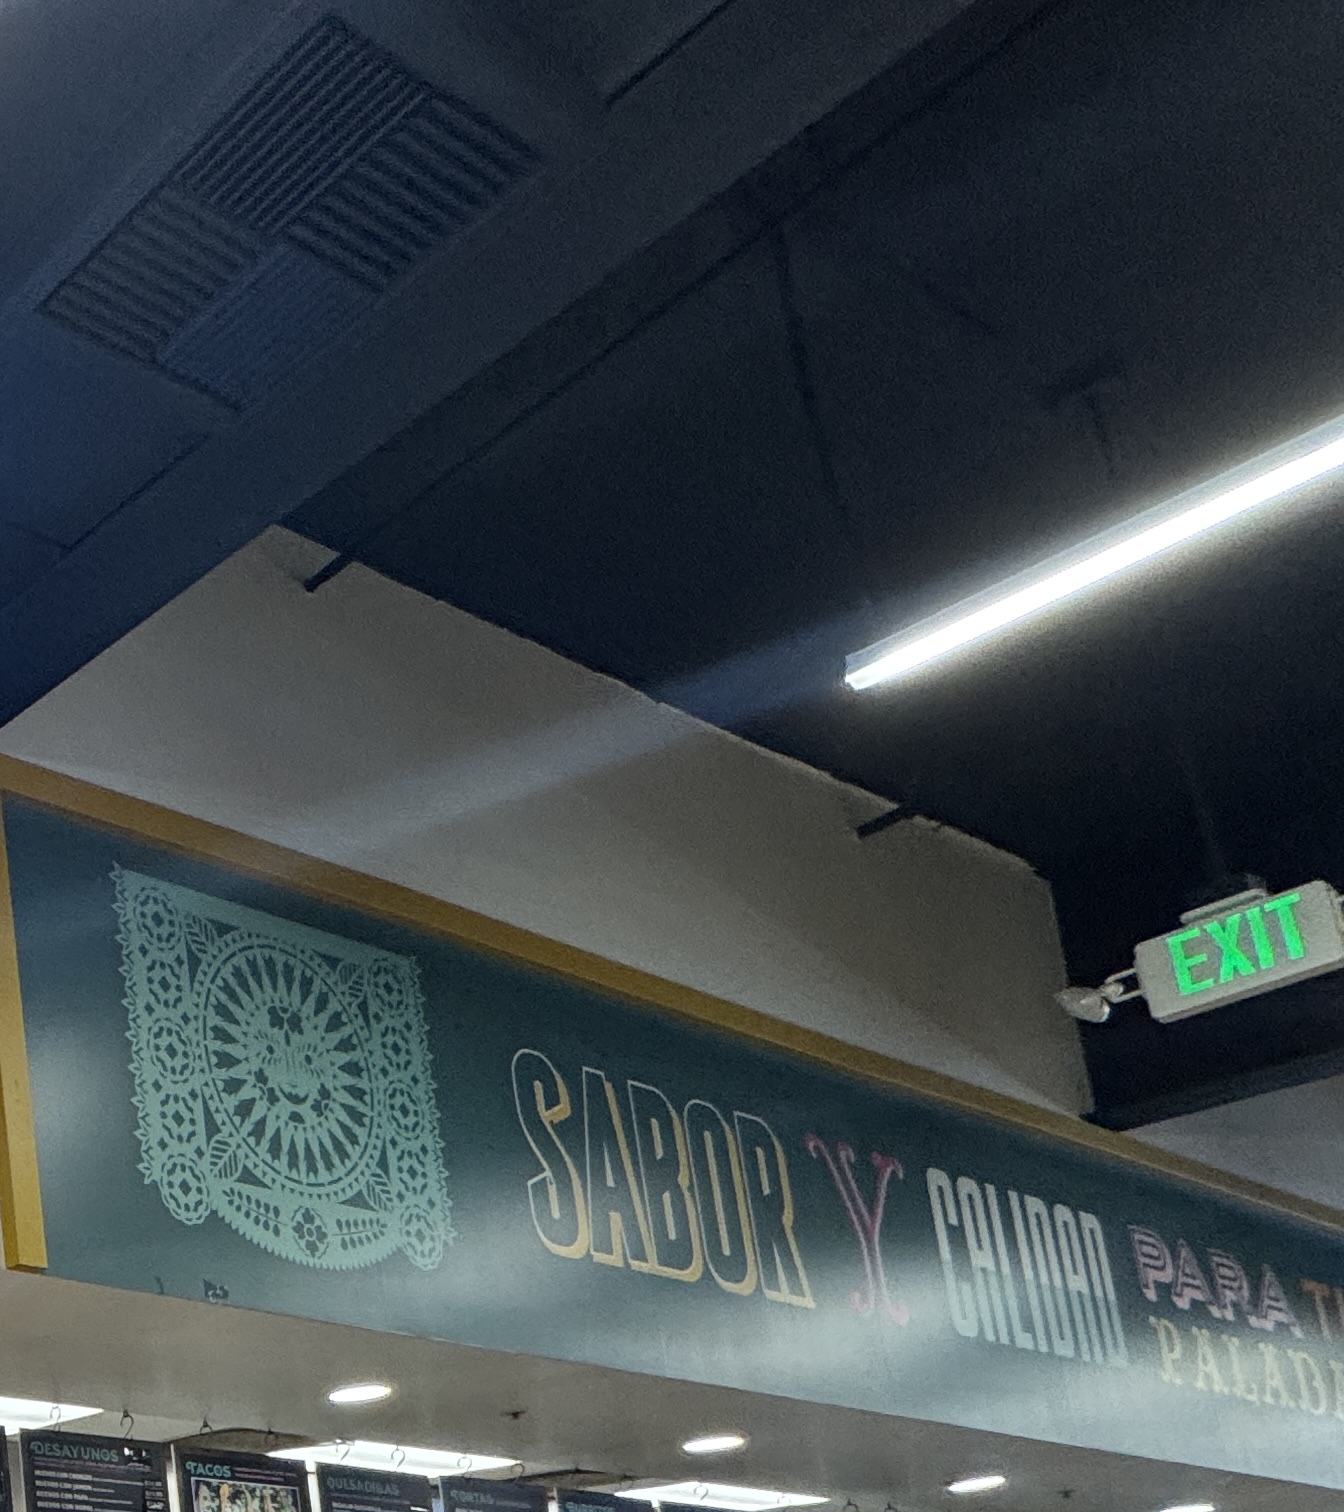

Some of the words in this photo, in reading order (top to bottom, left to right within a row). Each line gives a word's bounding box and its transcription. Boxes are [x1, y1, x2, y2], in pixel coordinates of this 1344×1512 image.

[1167, 893, 1305, 996] EXIT
[512, 1047, 815, 1309] SABOR
[803, 1133, 909, 1326] Y
[926, 1167, 1128, 1367] CALIDAD
[1127, 1224, 1305, 1339] PARA
[30, 1441, 119, 1463] DESAYUNOS
[185, 1461, 231, 1478] TACOS
